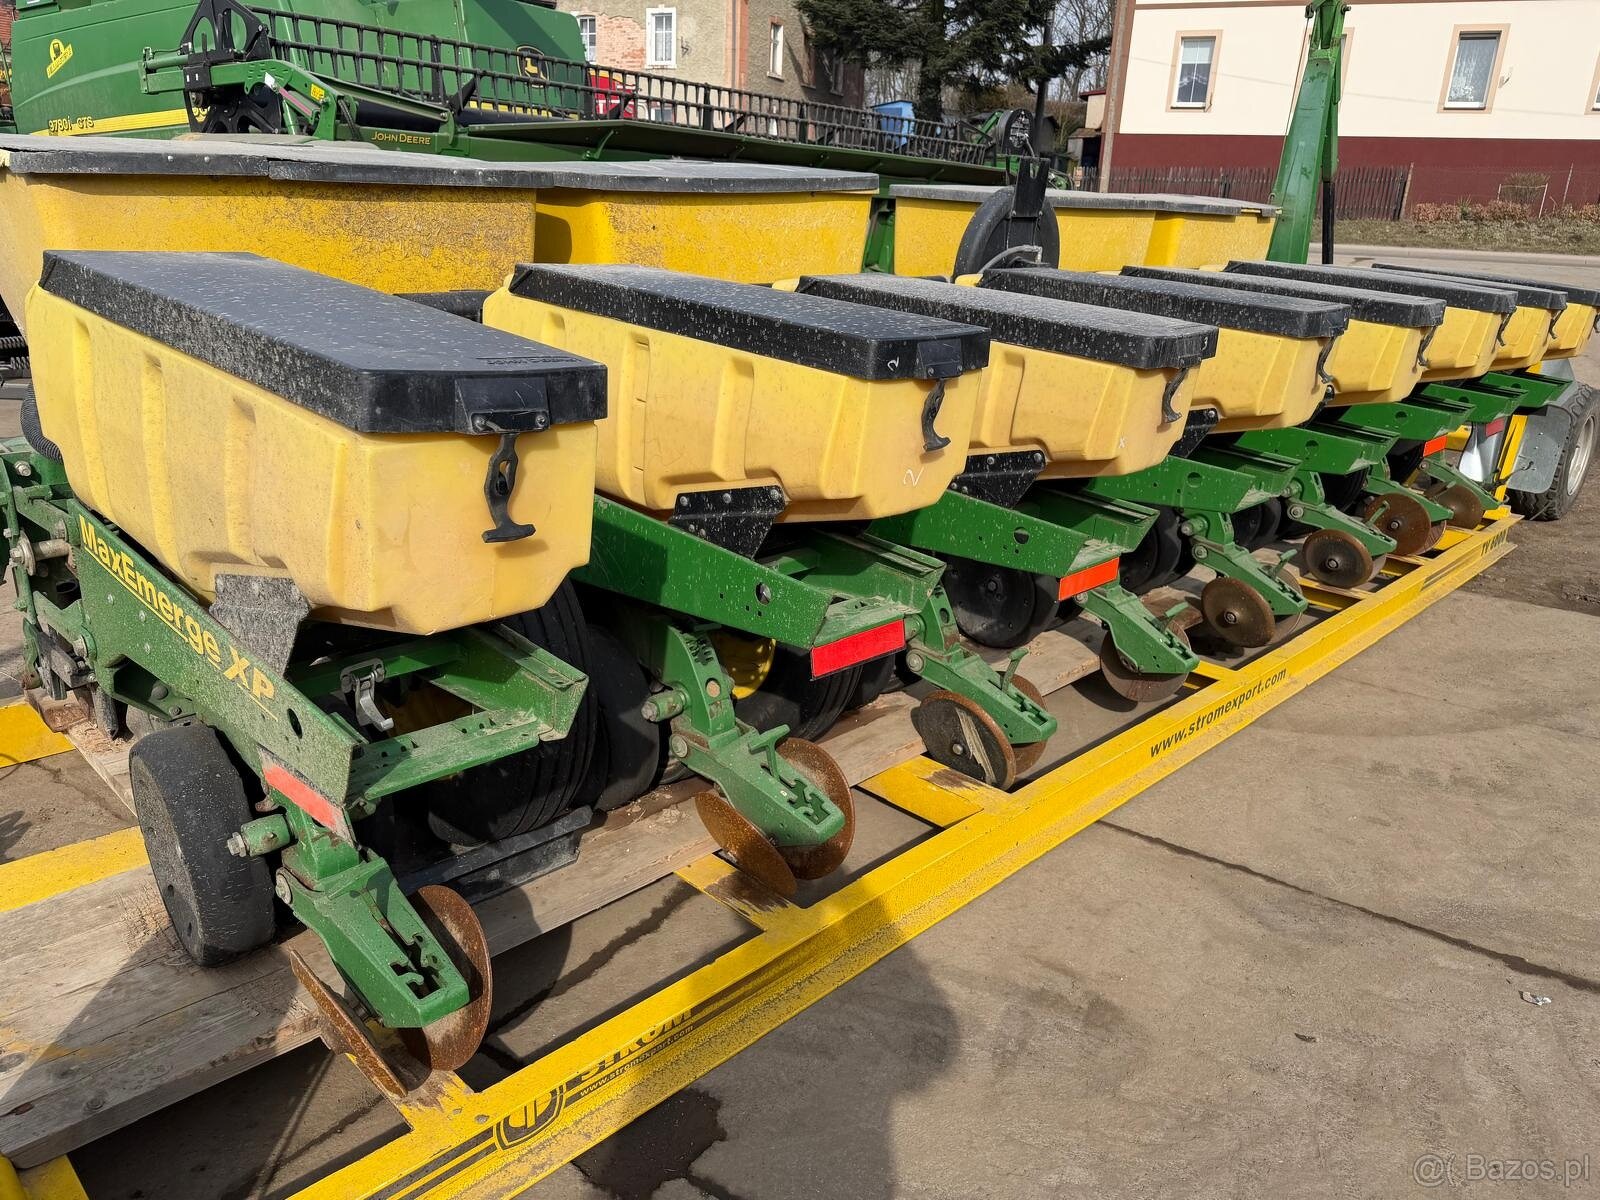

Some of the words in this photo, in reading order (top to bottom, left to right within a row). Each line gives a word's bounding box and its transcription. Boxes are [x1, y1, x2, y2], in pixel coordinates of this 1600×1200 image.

[371, 131, 398, 142] JOHN
[399, 133, 431, 145] DEERE
[79, 513, 222, 663] MaxEmerge
[223, 644, 276, 700] XP
[1150, 668, 1288, 758] www.stromexport.com
